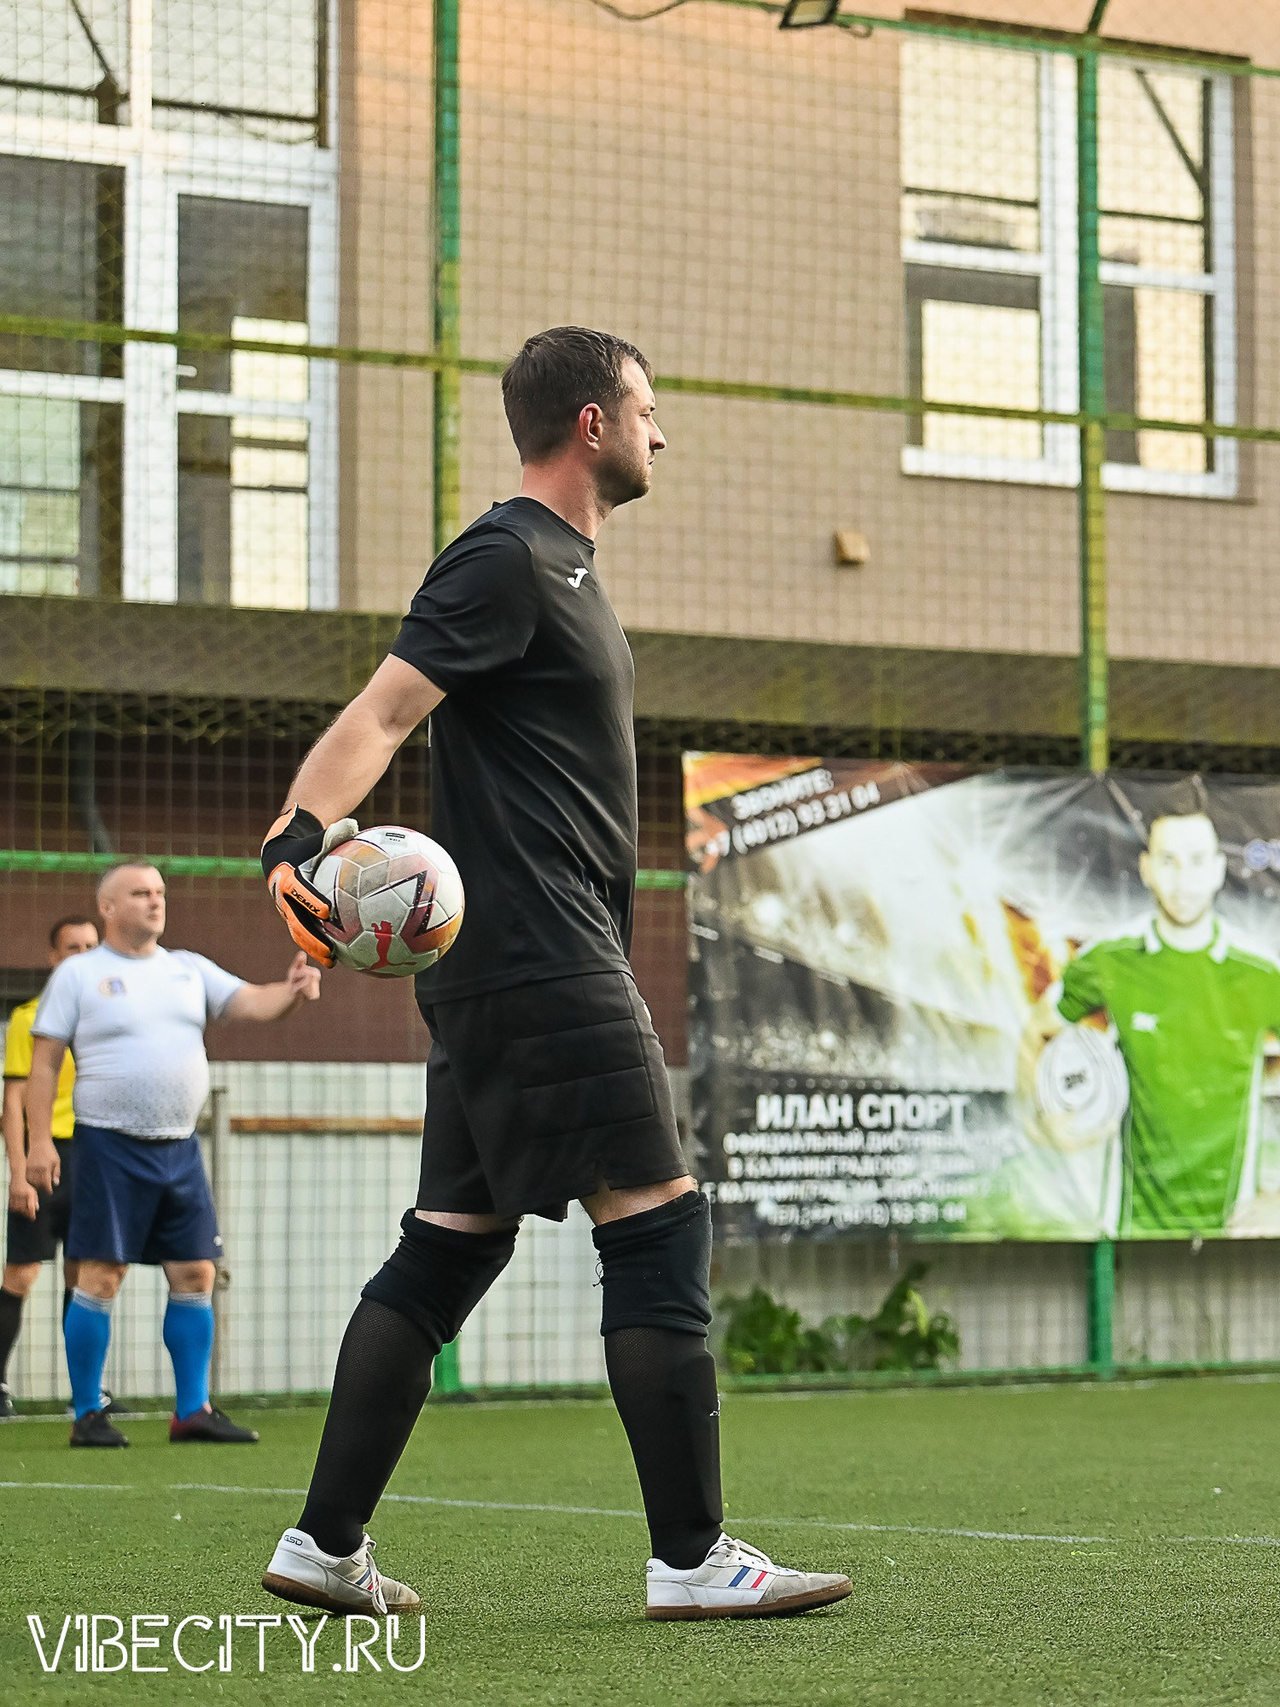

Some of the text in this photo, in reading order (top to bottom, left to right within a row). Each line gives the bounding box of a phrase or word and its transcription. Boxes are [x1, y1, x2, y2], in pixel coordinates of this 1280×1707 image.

[291, 888, 321, 915] DEMIX
[756, 1093, 972, 1133] ИЛАН СПОРТ
